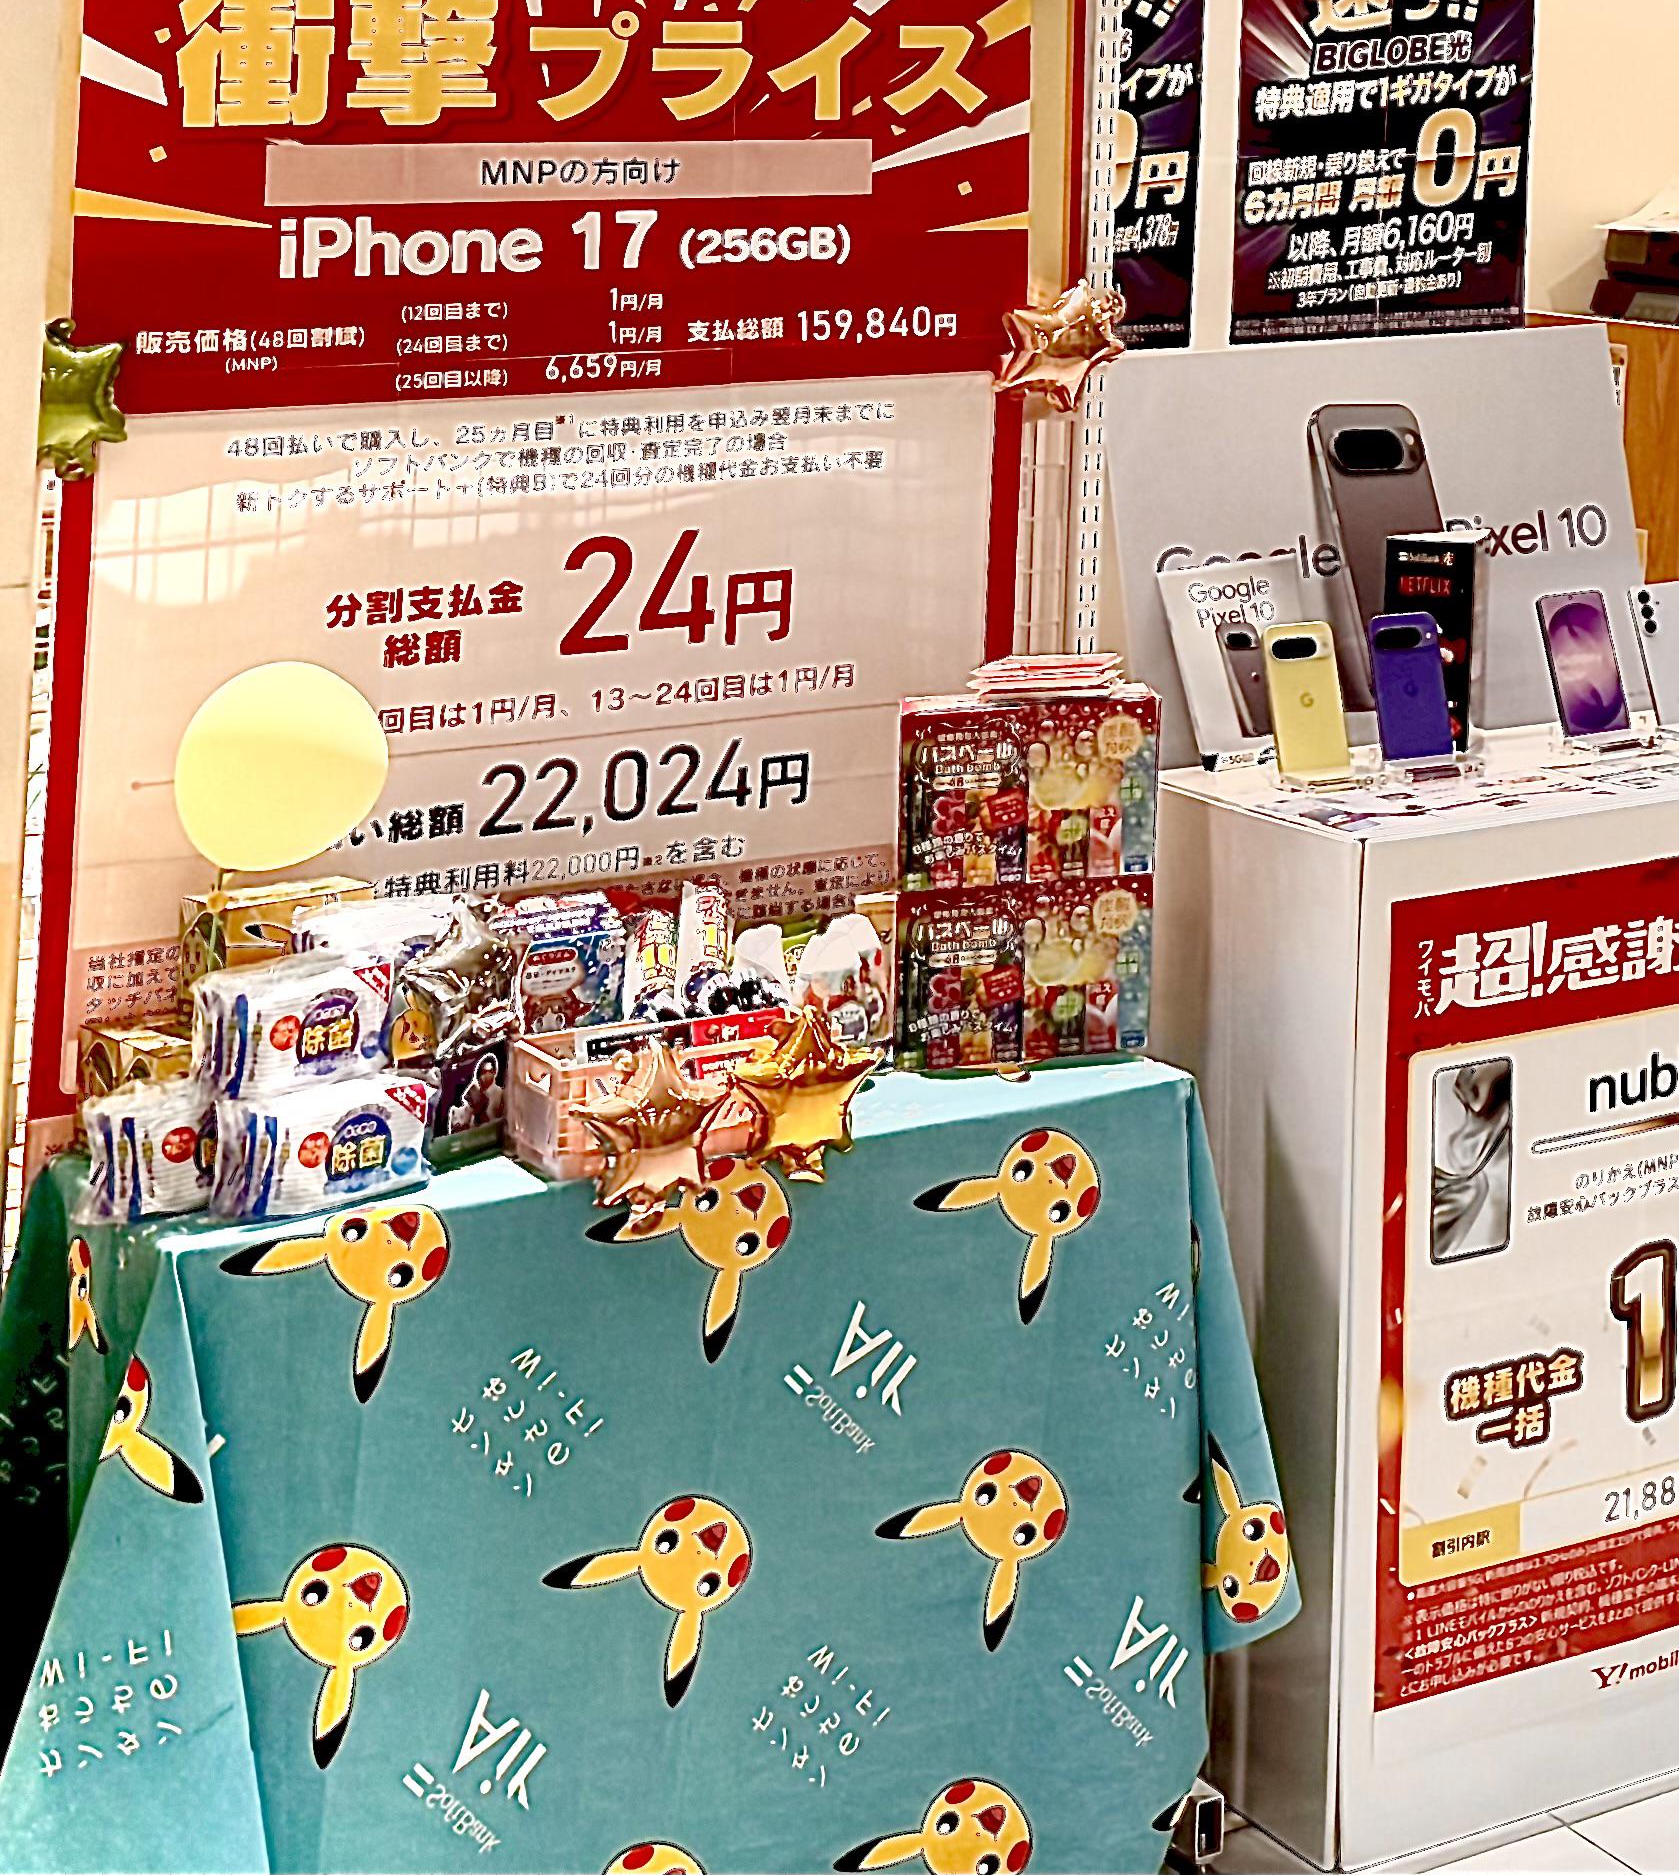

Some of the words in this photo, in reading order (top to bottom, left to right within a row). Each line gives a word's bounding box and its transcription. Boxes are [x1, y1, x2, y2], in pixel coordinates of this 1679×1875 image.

[1315, 30, 1472, 74] BIGLOBE光
[480, 154, 681, 188] MNPの方向け
[1413, 108, 1521, 208] 0円
[278, 215, 544, 280] iPhone
[571, 210, 657, 270] 17
[680, 225, 852, 271] (256GB)
[401, 301, 508, 323] (12回目まで)
[608, 287, 664, 312] 1円/月
[687, 317, 784, 343] 支払総額
[797, 306, 959, 343] 159,840円
[137, 325, 366, 358] 販売価格(48回割賦)
[397, 334, 508, 357] (24回目まで)
[608, 320, 662, 345] 1円/月
[224, 357, 280, 373] (MNP)
[395, 368, 508, 392] (25回目以降)
[545, 354, 662, 384] 6,659円/月
[1556, 504, 1607, 550] 10
[325, 582, 524, 630] 分割支払金
[560, 530, 794, 657] 24円
[1188, 576, 1270, 604] Google
[1197, 603, 1246, 628] Pixel
[1250, 600, 1275, 622] 10
[383, 631, 462, 669] 総額
[480, 741, 811, 840] 22,024円
[328, 804, 464, 849] い総額
[302, 1019, 354, 1058] 除菌
[331, 1136, 386, 1175] 除菌
[1447, 1350, 1582, 1418] 機種代金
[1480, 1405, 1549, 1446] 一括
